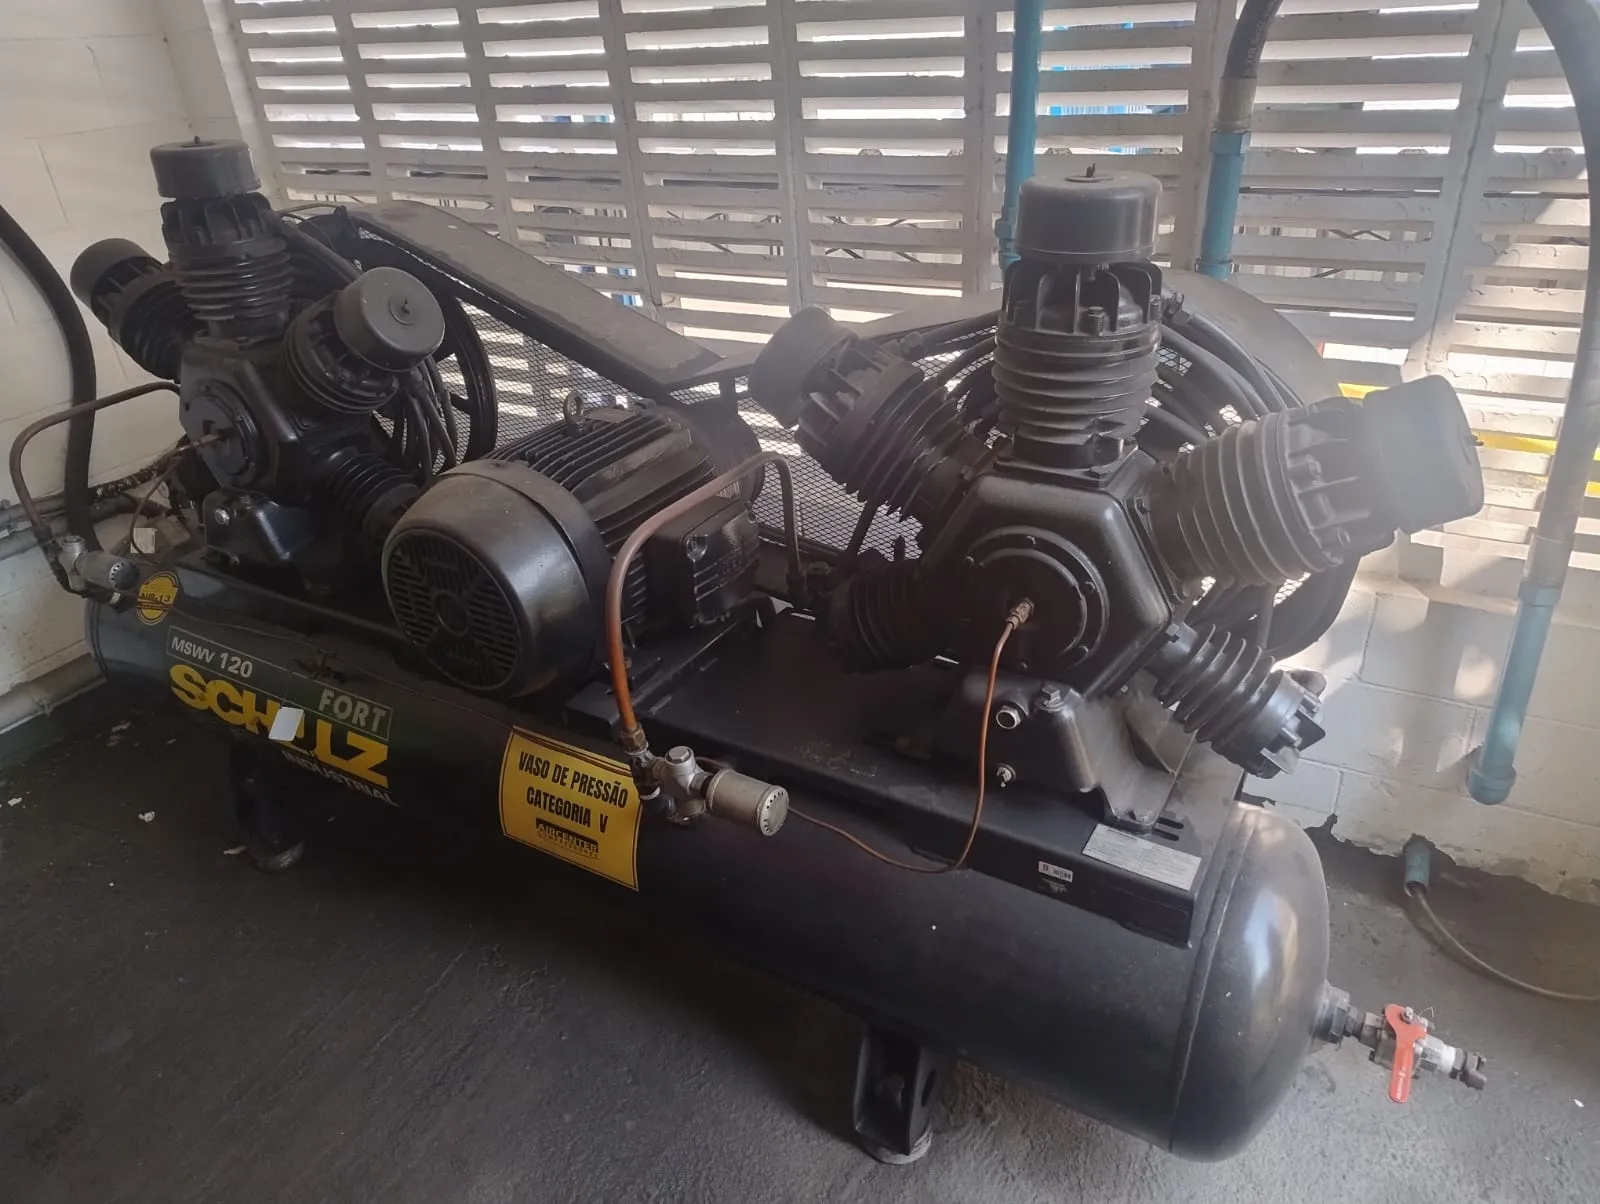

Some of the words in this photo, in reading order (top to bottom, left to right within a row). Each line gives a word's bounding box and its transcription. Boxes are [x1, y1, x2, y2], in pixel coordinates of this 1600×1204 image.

[171, 636, 214, 664] MSWV
[219, 652, 254, 678] 120
[319, 688, 387, 733] FORT
[518, 751, 550, 779] VASO
[551, 763, 570, 786] DE
[570, 771, 628, 809] PRESSÃO
[526, 786, 592, 828] CATEGORIA
[599, 814, 608, 833] V
